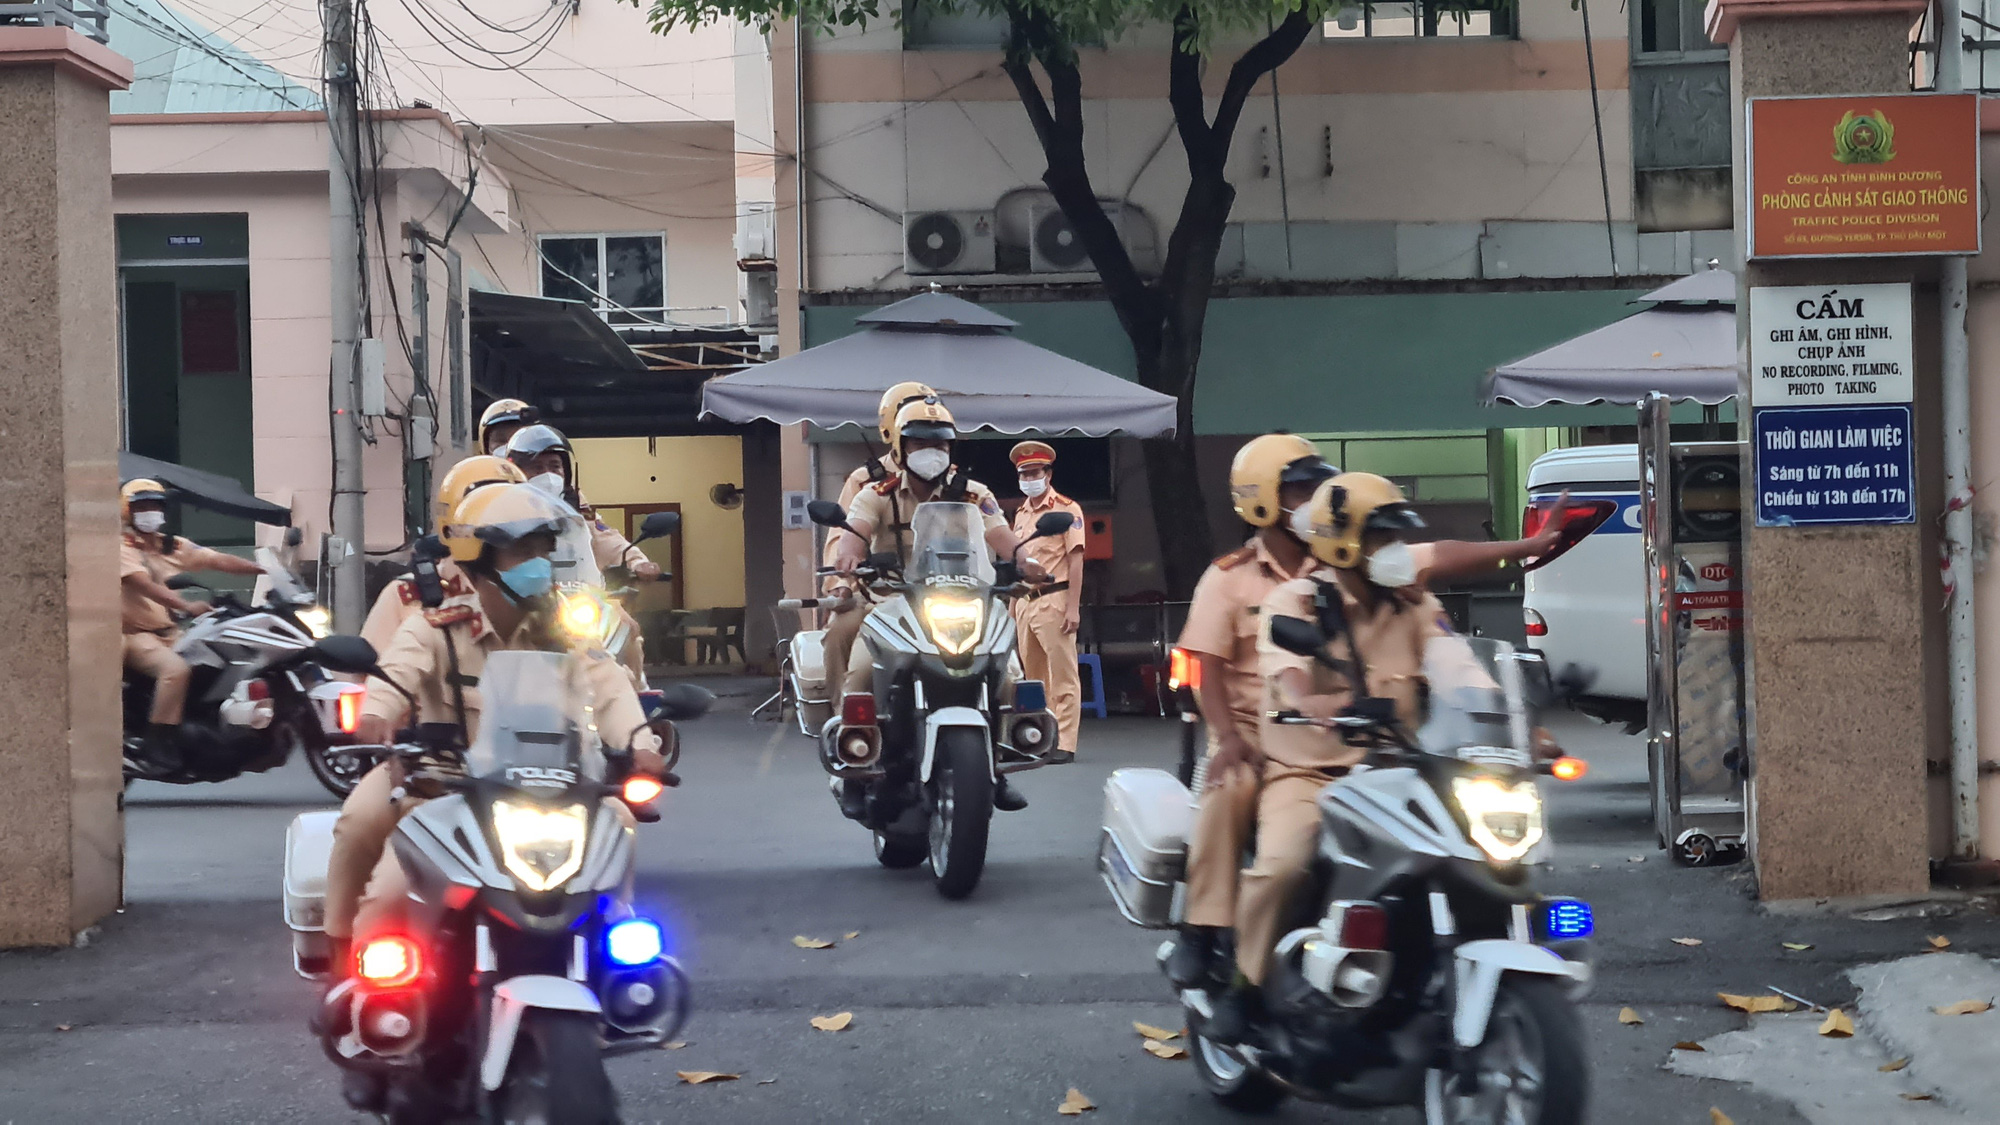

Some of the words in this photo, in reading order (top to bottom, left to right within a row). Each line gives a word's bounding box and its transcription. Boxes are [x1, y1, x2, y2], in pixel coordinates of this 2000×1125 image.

[1787, 173, 1819, 184] CÔNG
[1821, 174, 1838, 183] AN
[1869, 171, 1896, 182] BÌNH
[1762, 189, 1811, 209] PHÒNG
[1814, 186, 1852, 208] CẢNH
[1855, 186, 1879, 207] SÁT
[1882, 190, 1916, 206] GIAO
[1919, 184, 1968, 205] THÔNG
[1793, 216, 1839, 227] TRAFFIC
[1842, 215, 1882, 225] POLICE
[1886, 213, 1940, 224] DIVISION
[1796, 289, 1864, 319] CẤM
[1770, 330, 1794, 342] GHI
[1798, 326, 1823, 342] ÂM,
[1827, 328, 1851, 341] GHI
[1855, 324, 1892, 340] HÌNH,
[1798, 346, 1834, 361] CHỤP
[1837, 341, 1865, 358] ẢNH
[1762, 366, 1777, 378] NO
[1781, 364, 1848, 378] RECORDING,
[1852, 362, 1902, 376] FILMING,
[1788, 383, 1824, 395] PHOTO
[1835, 381, 1877, 394] TAKING
[1765, 426, 1795, 450] THỜI
[1800, 429, 1834, 449] GIAN
[1838, 425, 1867, 448] LÀM
[1871, 424, 1902, 451] VIỆC
[1770, 465, 1804, 482] Sáng
[1808, 464, 1821, 479] từ
[1824, 465, 1841, 479] 7h
[1845, 461, 1870, 479] đến
[1874, 463, 1899, 478] 11h
[1824, 490, 1848, 504] 13h
[1852, 487, 1877, 504] đến
[1881, 488, 1906, 503] 17h
[925, 574, 978, 587] POLICE
